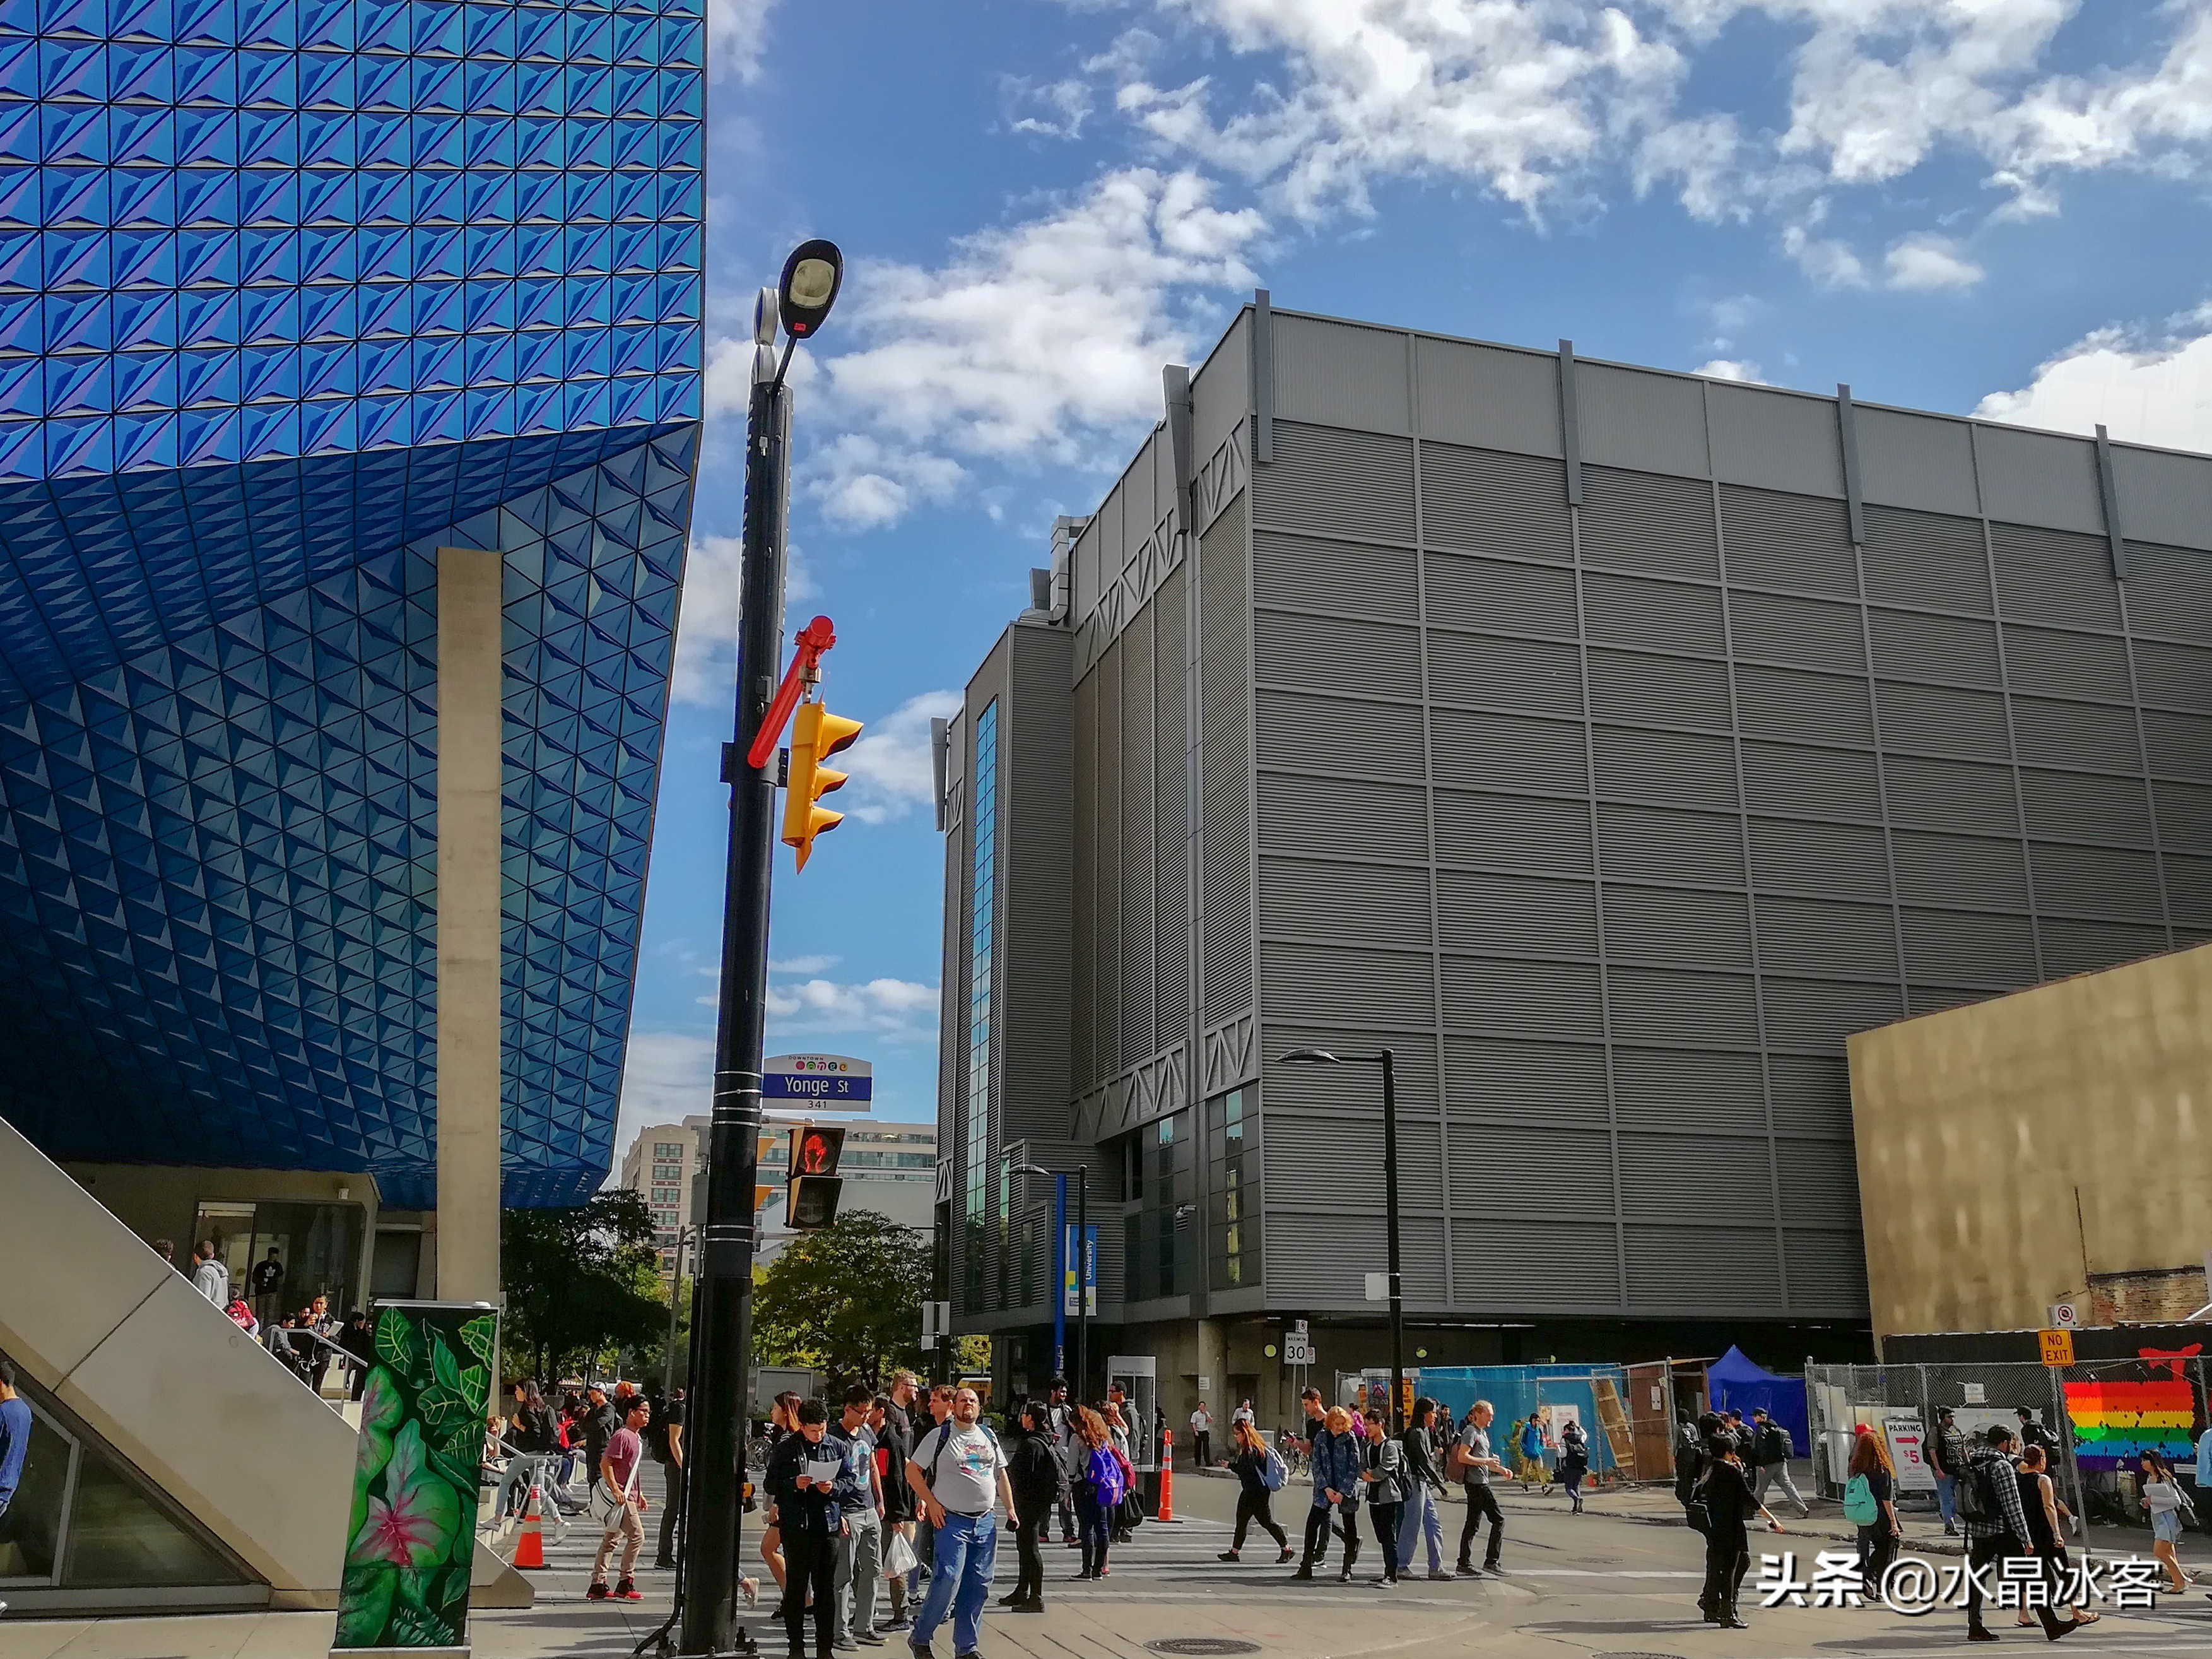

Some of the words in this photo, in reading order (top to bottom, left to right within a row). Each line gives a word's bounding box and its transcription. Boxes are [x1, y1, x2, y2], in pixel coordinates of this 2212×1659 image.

[784, 1077, 829, 1096] Yonge
[837, 1080, 849, 1093] St
[808, 1101, 827, 1109] 341
[1085, 1239, 1093, 1280] University
[2047, 1335, 2062, 1346] NO
[1287, 1345, 1305, 1359] 30
[2045, 1350, 2068, 1361] EXIT
[1903, 1449, 1920, 1463] $5
